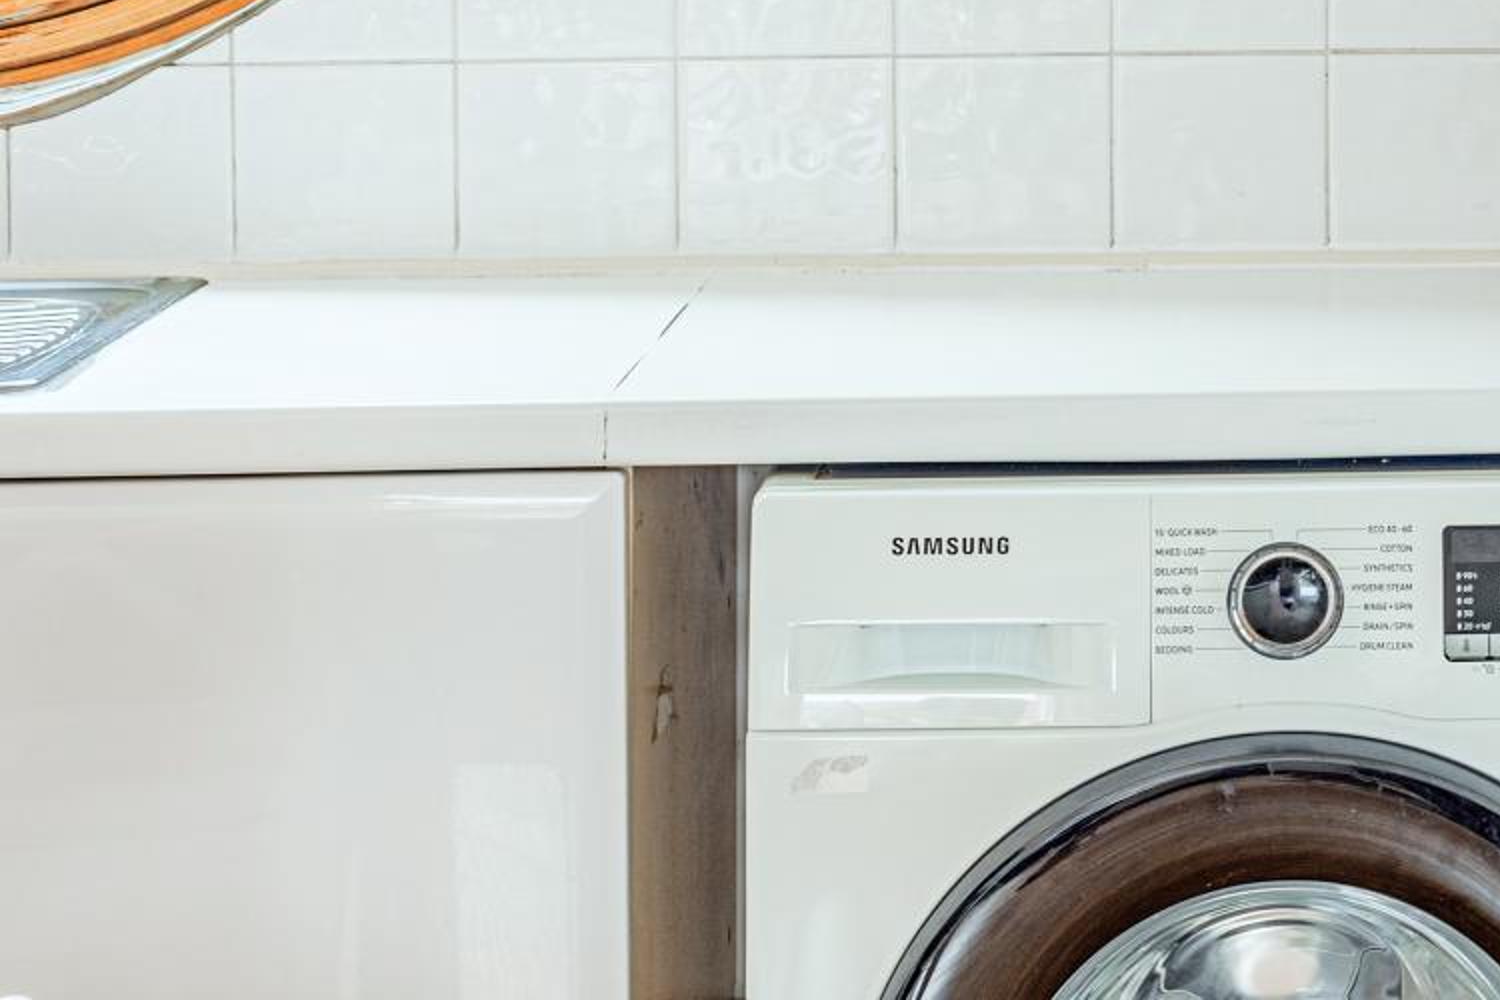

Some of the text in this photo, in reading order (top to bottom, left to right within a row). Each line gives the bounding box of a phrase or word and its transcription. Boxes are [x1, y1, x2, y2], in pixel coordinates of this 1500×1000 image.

[1167, 527, 1192, 537] QUICK
[1194, 527, 1217, 537] WASH
[891, 536, 1009, 555] SAMSUNG
[1380, 543, 1412, 553] COTTON
[1183, 547, 1207, 556] LOAD
[1154, 567, 1199, 577] DELICATES
[1363, 563, 1413, 573] SYNTHETICS
[1155, 587, 1180, 596] WOOL
[1386, 583, 1413, 592] STEAM
[1155, 605, 1215, 615] INTENSE COLD
[1155, 625, 1195, 635] COLOURS
